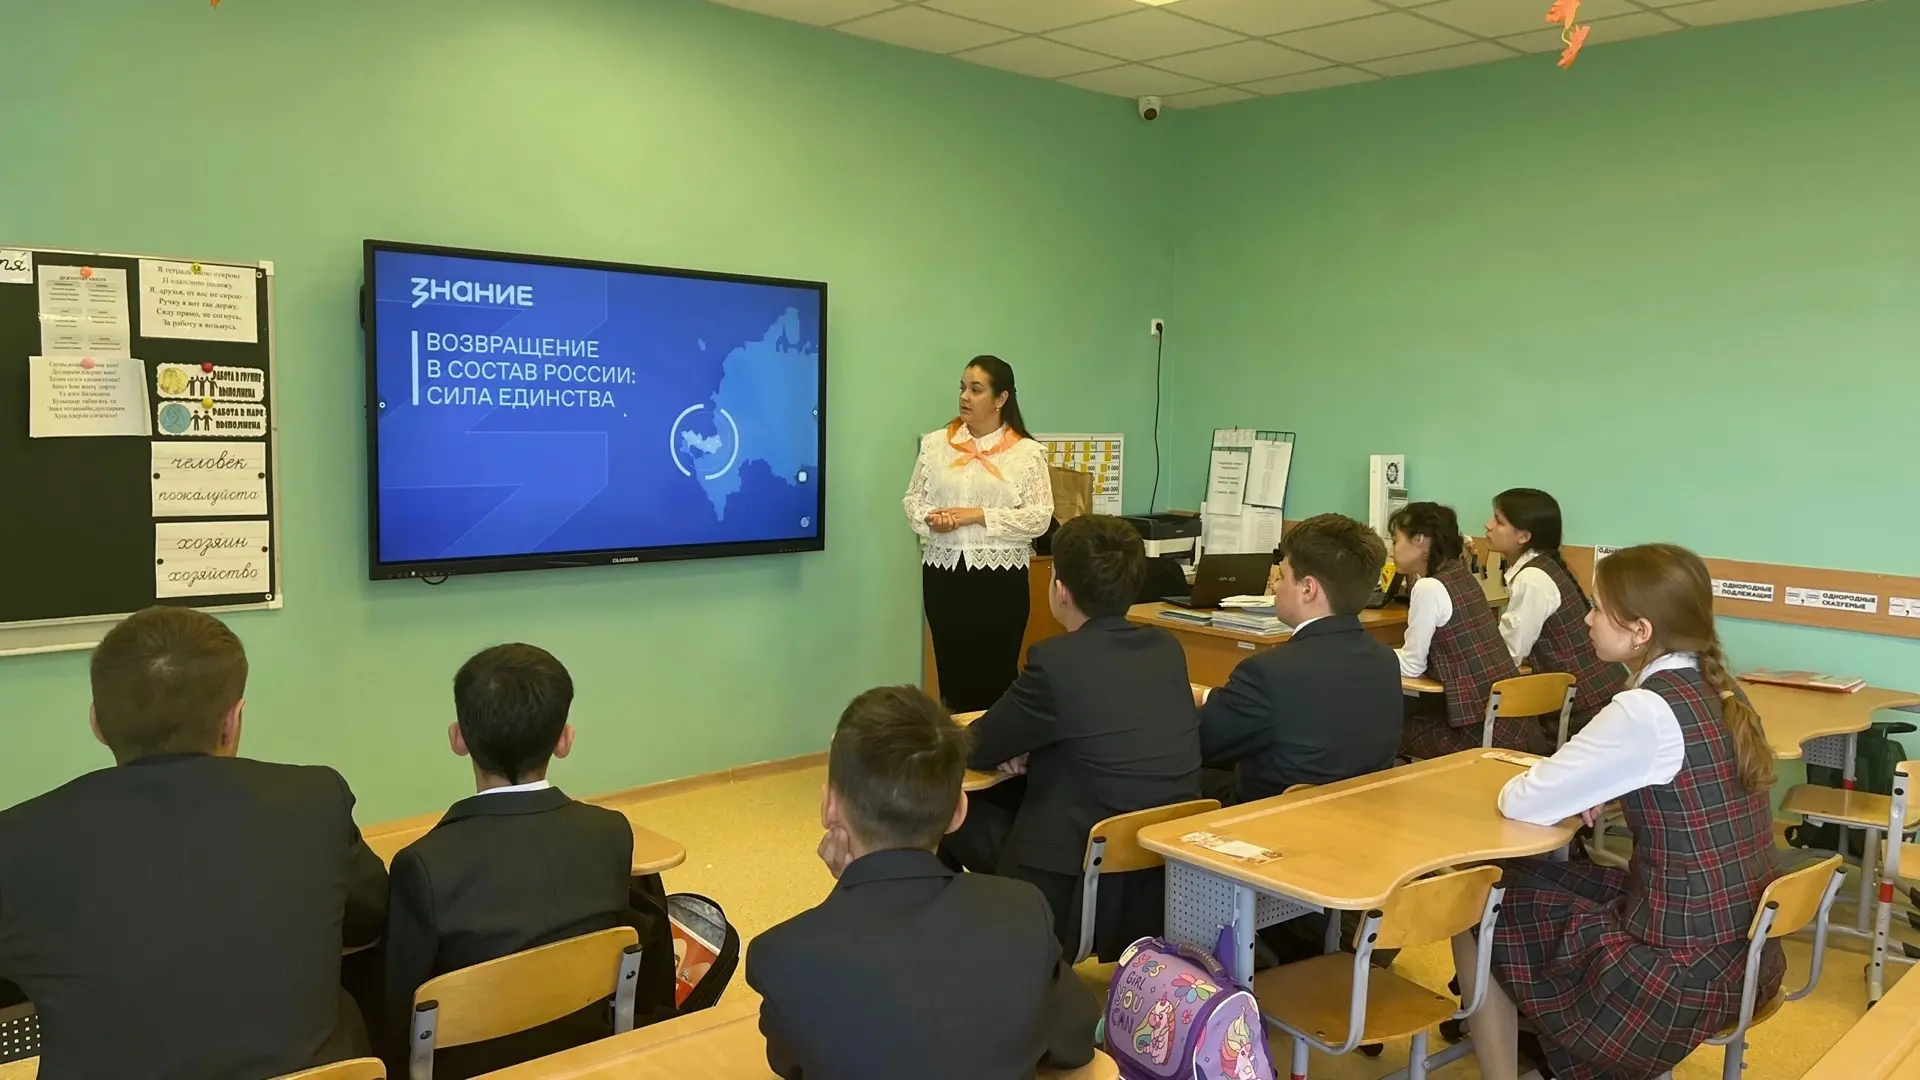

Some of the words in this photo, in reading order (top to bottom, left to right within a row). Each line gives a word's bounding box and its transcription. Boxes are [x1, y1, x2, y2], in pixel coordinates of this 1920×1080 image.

[159, 298, 180, 306] Ручку
[156, 308, 174, 316] Сяду
[172, 320, 196, 328] работу
[427, 332, 600, 358] ВОЗВРАЩЕНИЕ
[212, 370, 234, 381] РАБОТА
[236, 372, 240, 382] В
[427, 359, 441, 378] В
[448, 360, 537, 381] СОСТАВ
[544, 363, 636, 384] РОССИИ:
[218, 387, 256, 398] ВЫПОЛНЕНА
[427, 386, 494, 406] СИЛА
[499, 388, 615, 410] ЕДИНСТВА
[212, 408, 238, 416] РАБОТА
[240, 408, 244, 416] В
[246, 408, 264, 417] ПАРЕ
[216, 420, 260, 430] ВЫПОЛНЕНА
[1722, 582, 1772, 593] ОДНОРОДНЫЕ
[1722, 589, 1772, 600] ПОДЛЕЖАЩИЕ
[1822, 592, 1876, 604] ОДНОРОДНЫЕ
[1822, 600, 1866, 610] СКАЗУЕМЫЕ
[1112, 1008, 1134, 1034] CAN
